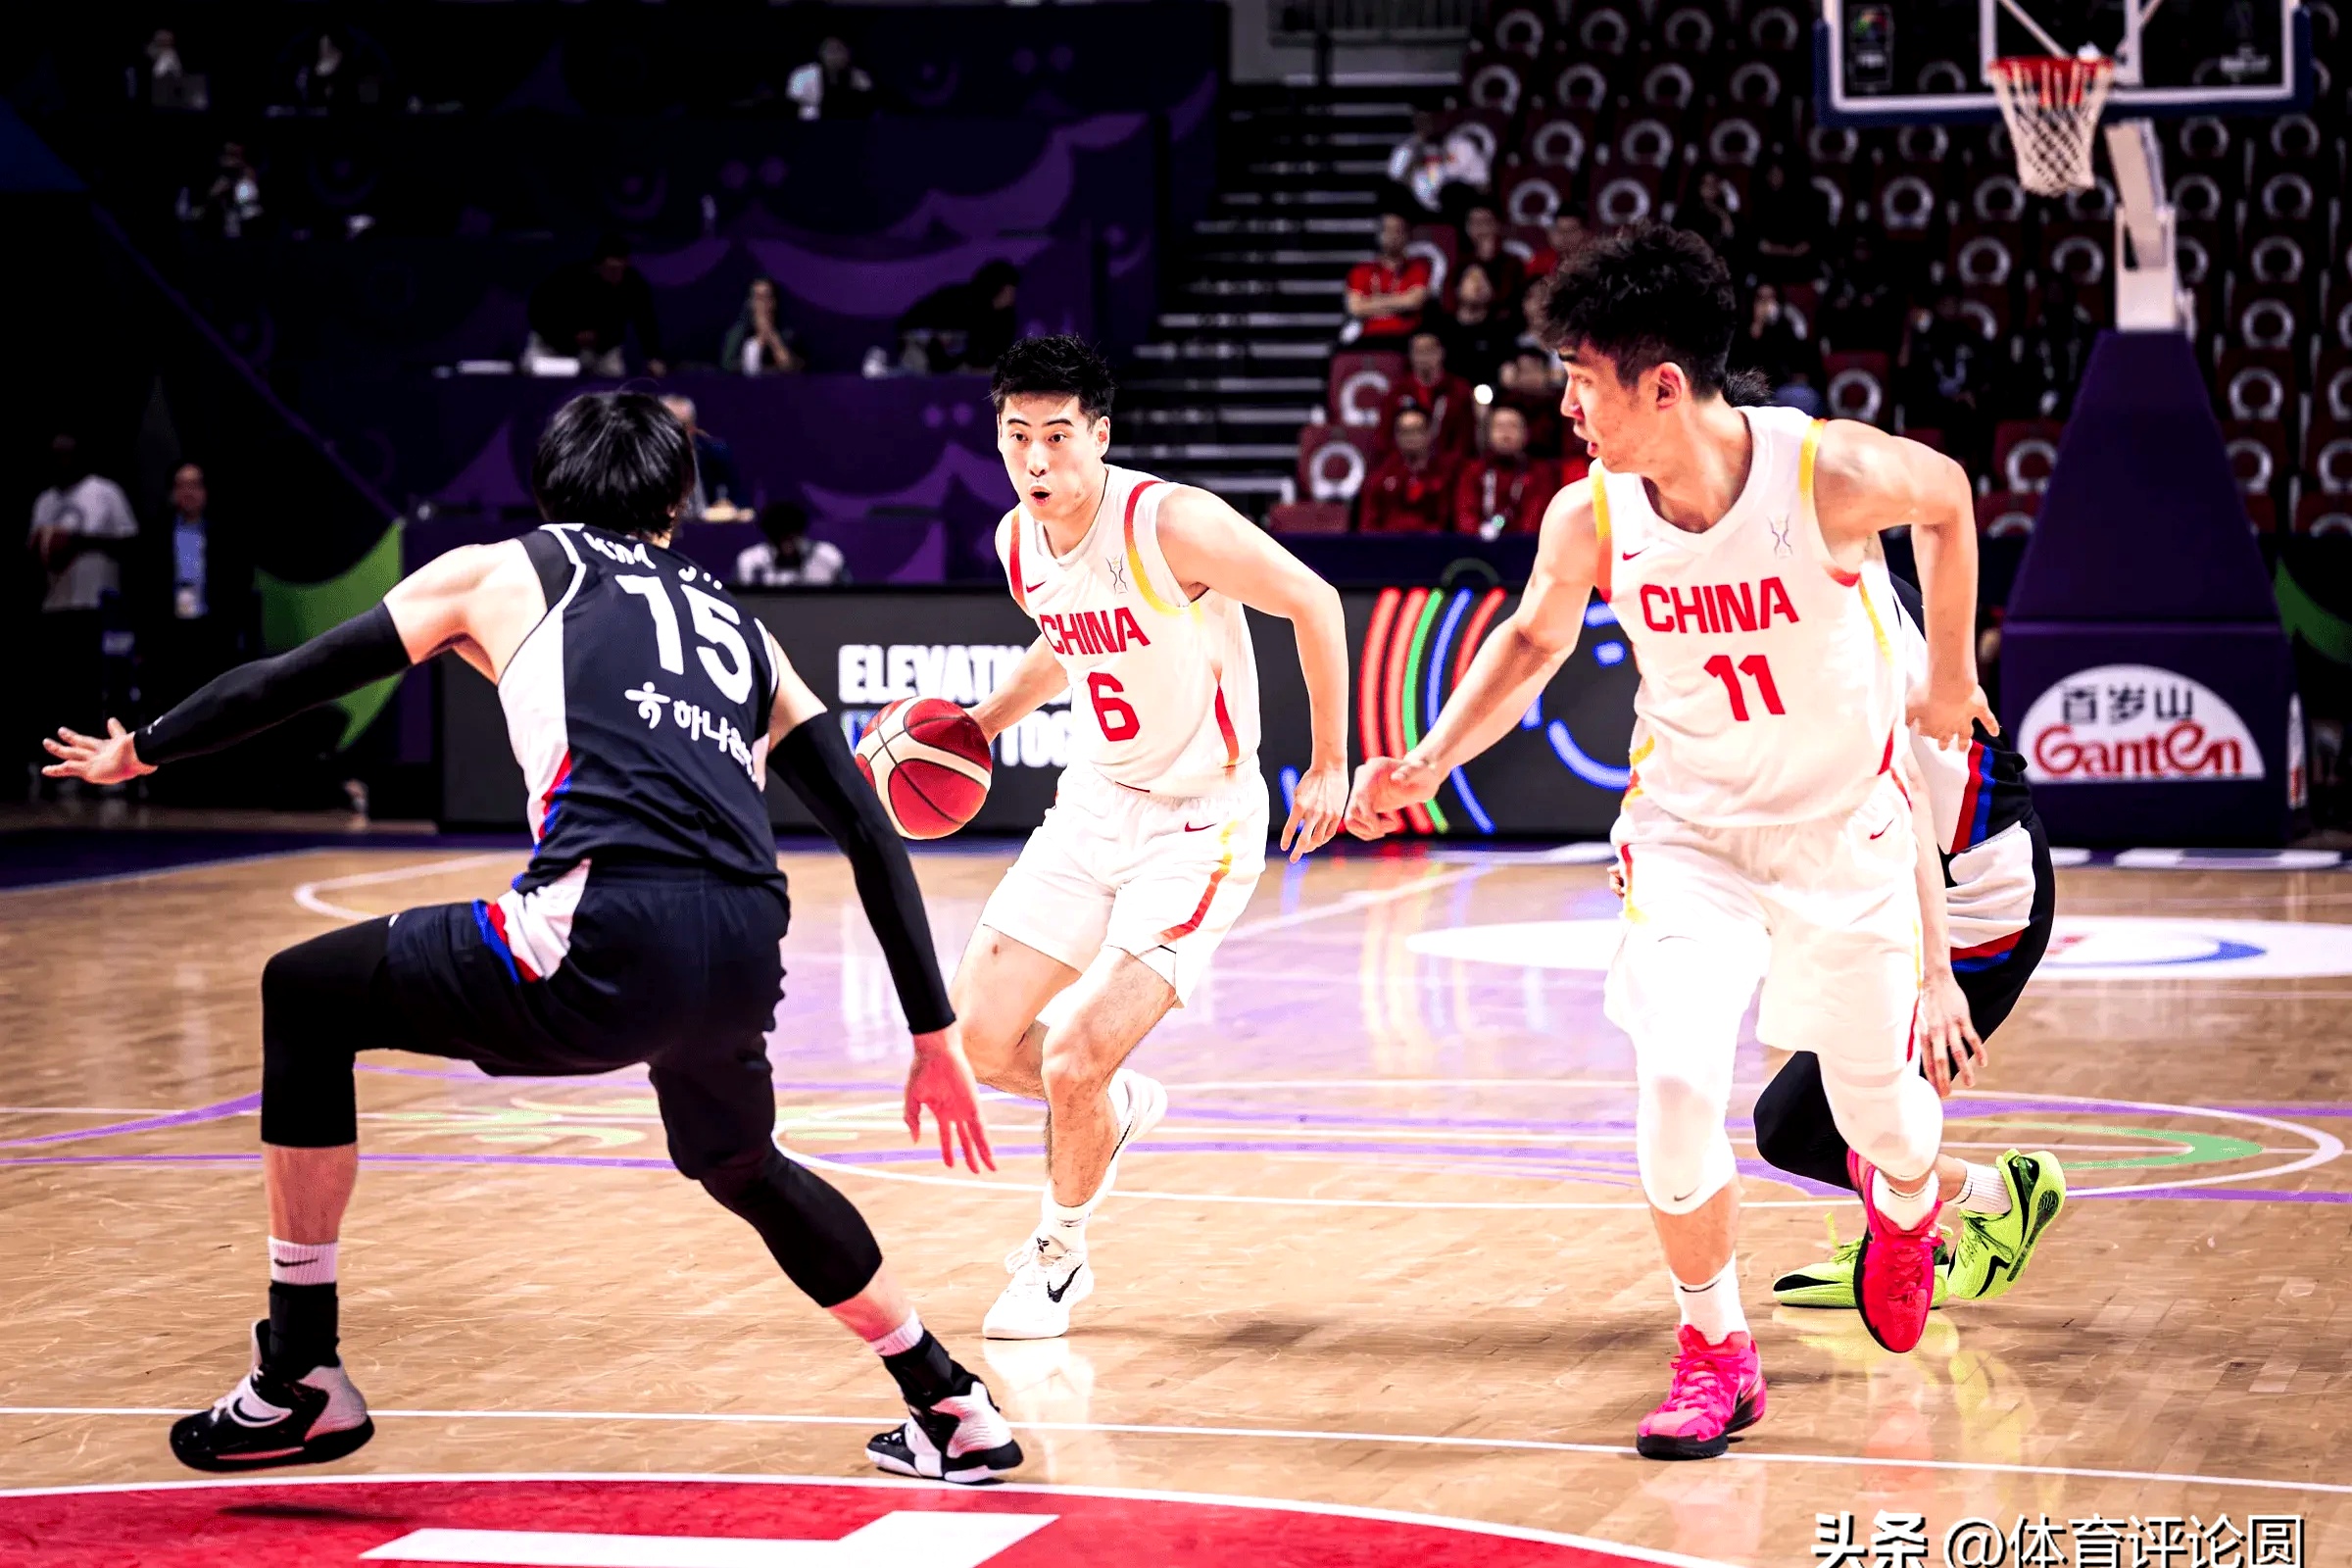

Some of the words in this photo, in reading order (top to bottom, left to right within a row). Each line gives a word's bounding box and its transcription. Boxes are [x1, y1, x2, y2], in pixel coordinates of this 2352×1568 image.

[1039, 606, 1152, 656] CHINA
[1641, 576, 1800, 634] CHINA
[1087, 671, 1141, 743] 6
[1703, 655, 1787, 722] 11
[2062, 684, 2194, 725] 百岁山
